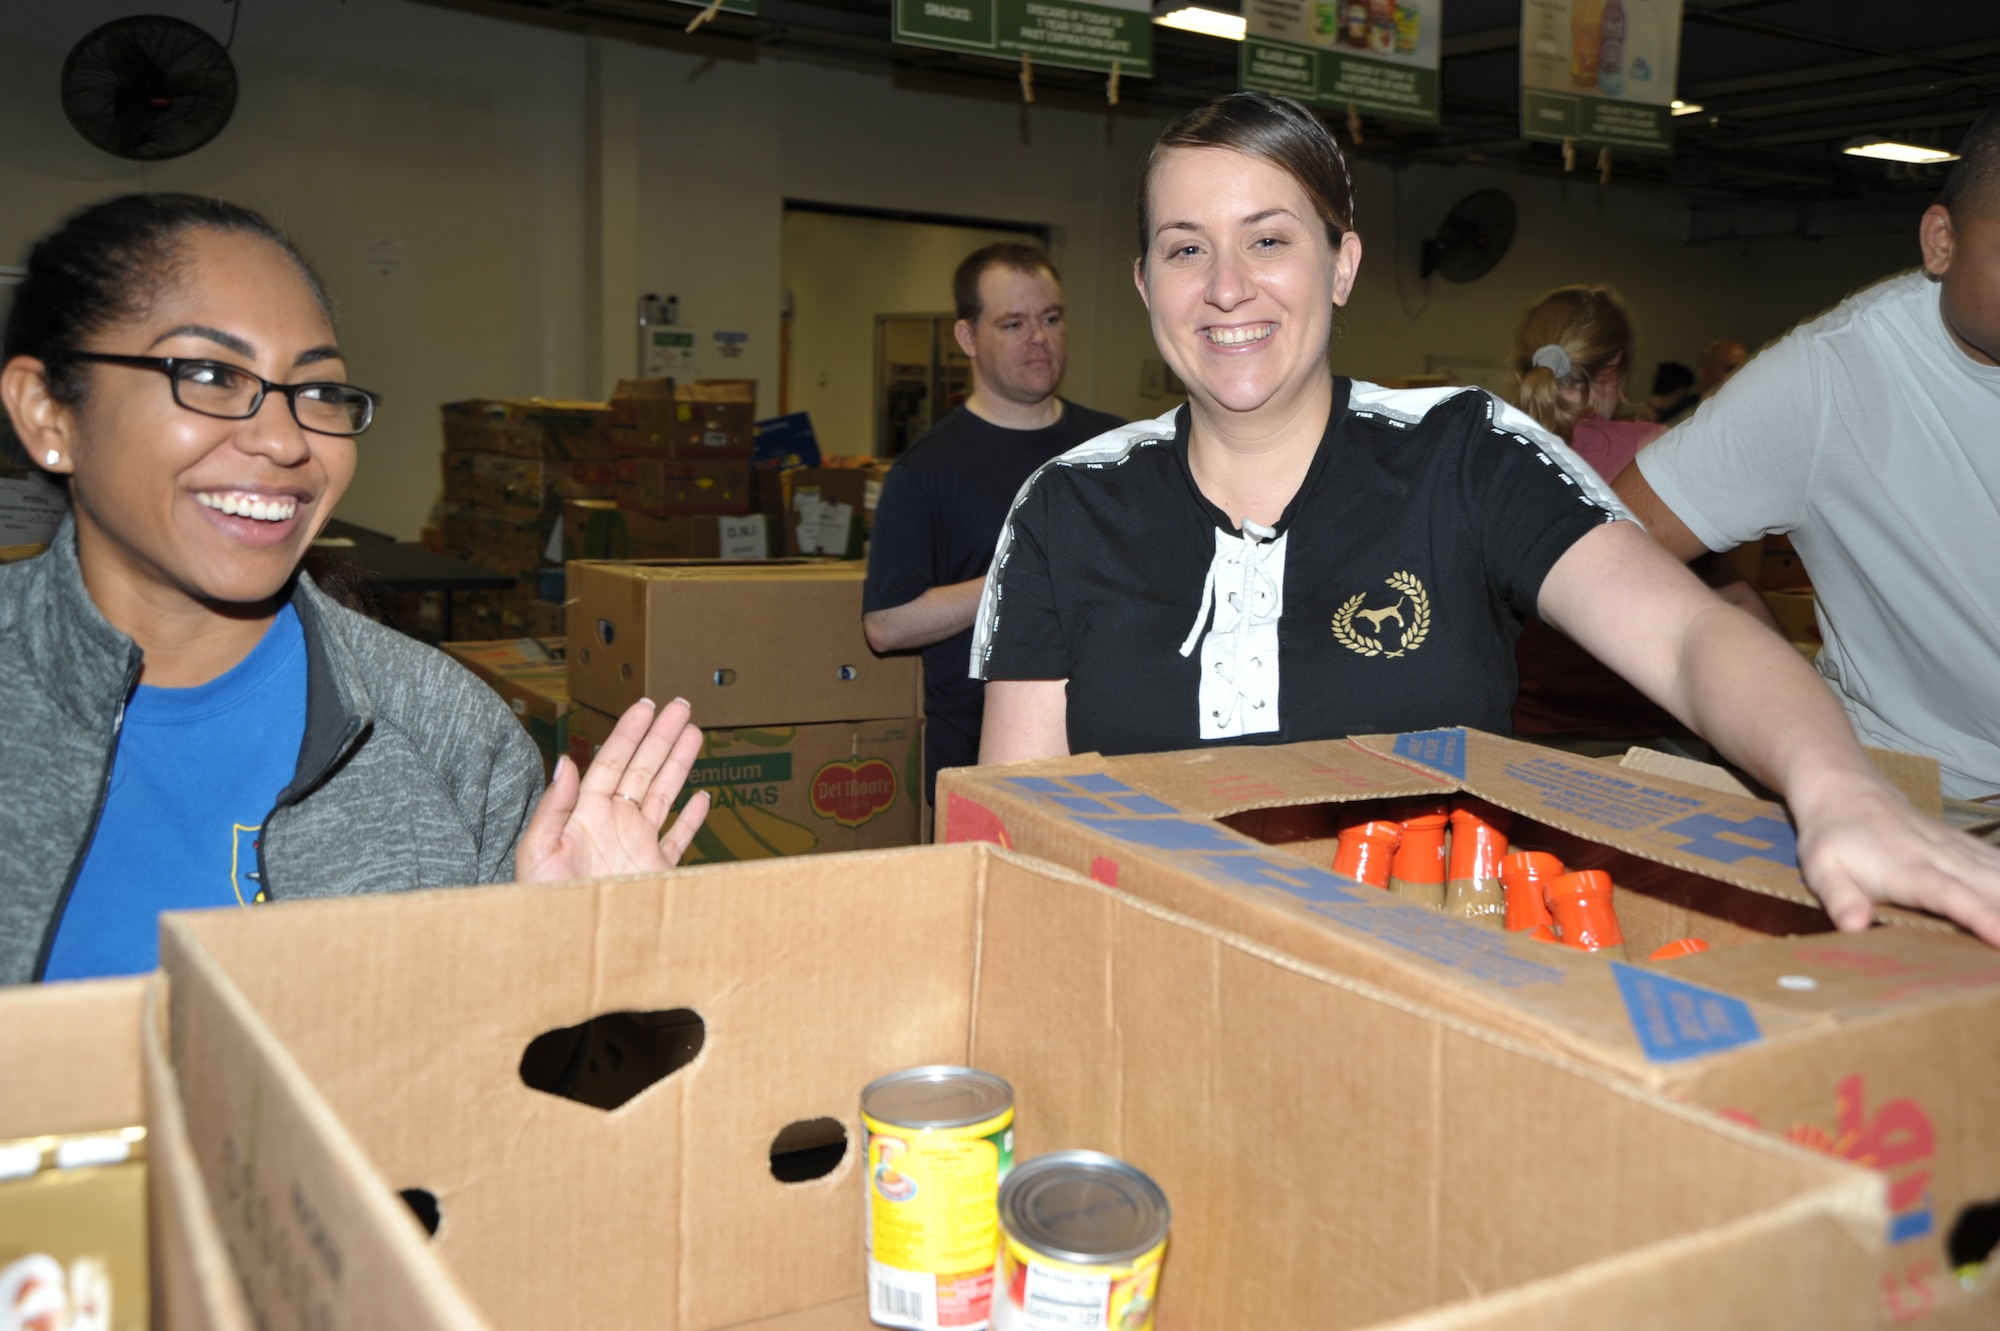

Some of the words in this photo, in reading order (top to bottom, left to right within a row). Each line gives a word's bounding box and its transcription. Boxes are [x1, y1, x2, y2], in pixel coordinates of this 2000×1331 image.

[924, 2, 972, 22] SNACKS
[1080, 10, 1110, 26] TODAY
[1020, 27, 1046, 41] PAST
[1355, 411, 1374, 419] PINK
[1388, 420, 1406, 429] PINK
[1140, 440, 1158, 448] PINK
[1536, 452, 1553, 466] PINK
[1558, 473, 1575, 486] PINK
[687, 762, 763, 785] emium
[818, 782, 842, 799] Del
[844, 778, 892, 797] Monte
[1465, 901, 1505, 919] Anni
